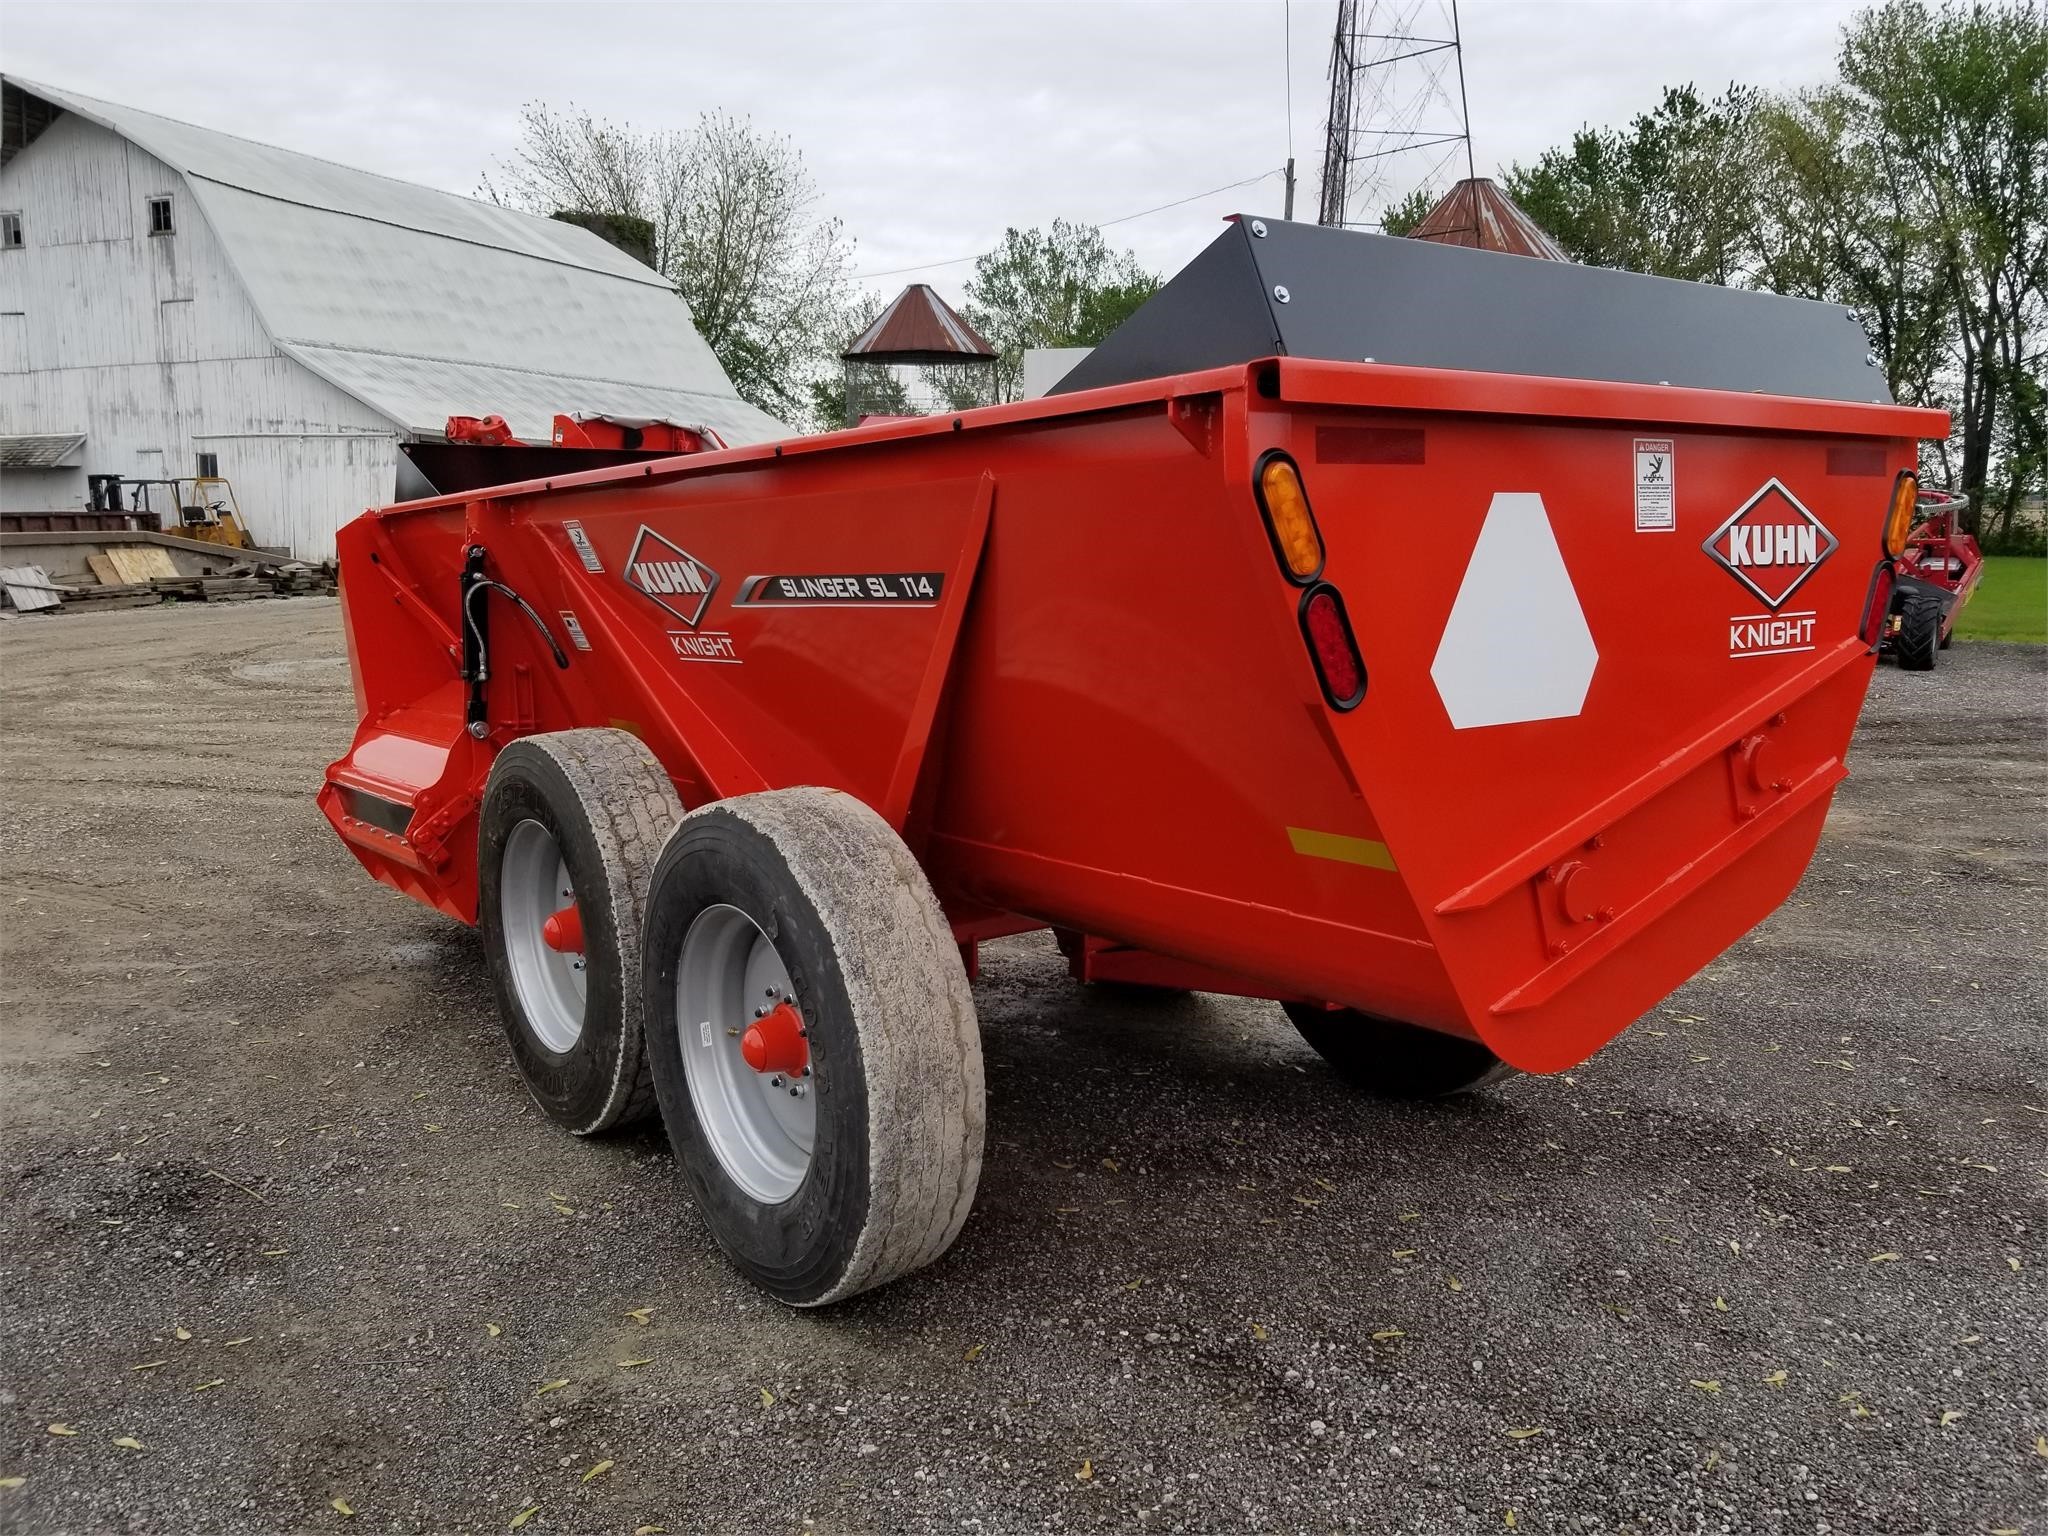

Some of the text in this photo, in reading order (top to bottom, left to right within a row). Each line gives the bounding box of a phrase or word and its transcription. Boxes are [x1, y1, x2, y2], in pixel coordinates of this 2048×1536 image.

[1645, 442, 1669, 452] DANGER
[1730, 525, 1817, 566] KUHN
[633, 560, 708, 593] KUHN
[779, 576, 934, 598] SLINGER SL 114
[670, 636, 736, 657] KNIGHT
[1730, 619, 1816, 650] KNIGHT
